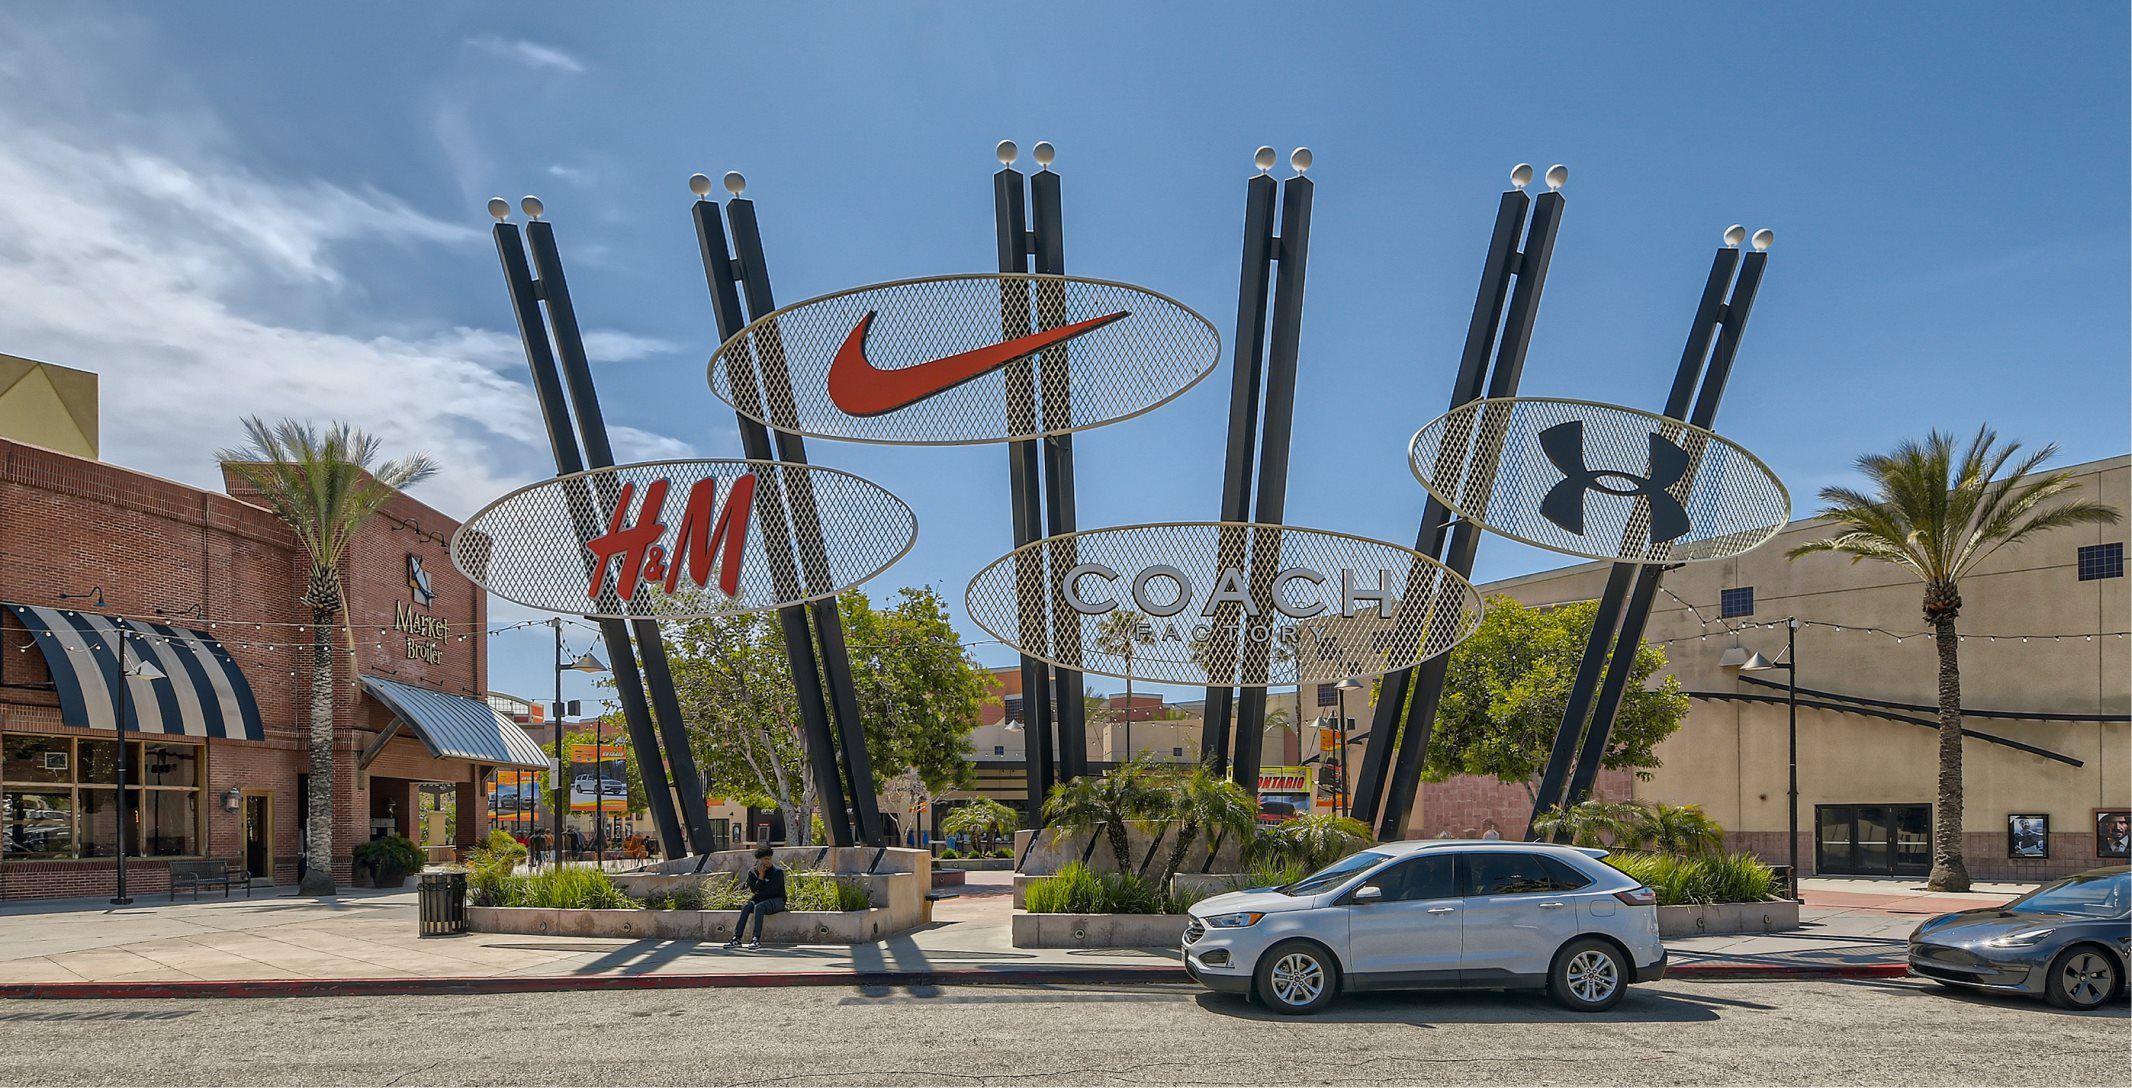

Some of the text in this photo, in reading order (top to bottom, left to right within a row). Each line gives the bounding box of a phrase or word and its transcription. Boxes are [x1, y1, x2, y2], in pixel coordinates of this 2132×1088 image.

[586, 473, 757, 600] H&M
[1062, 563, 1393, 619] COACH
[406, 637, 443, 665] Broiler
[1134, 623, 1326, 644] FACTORY
